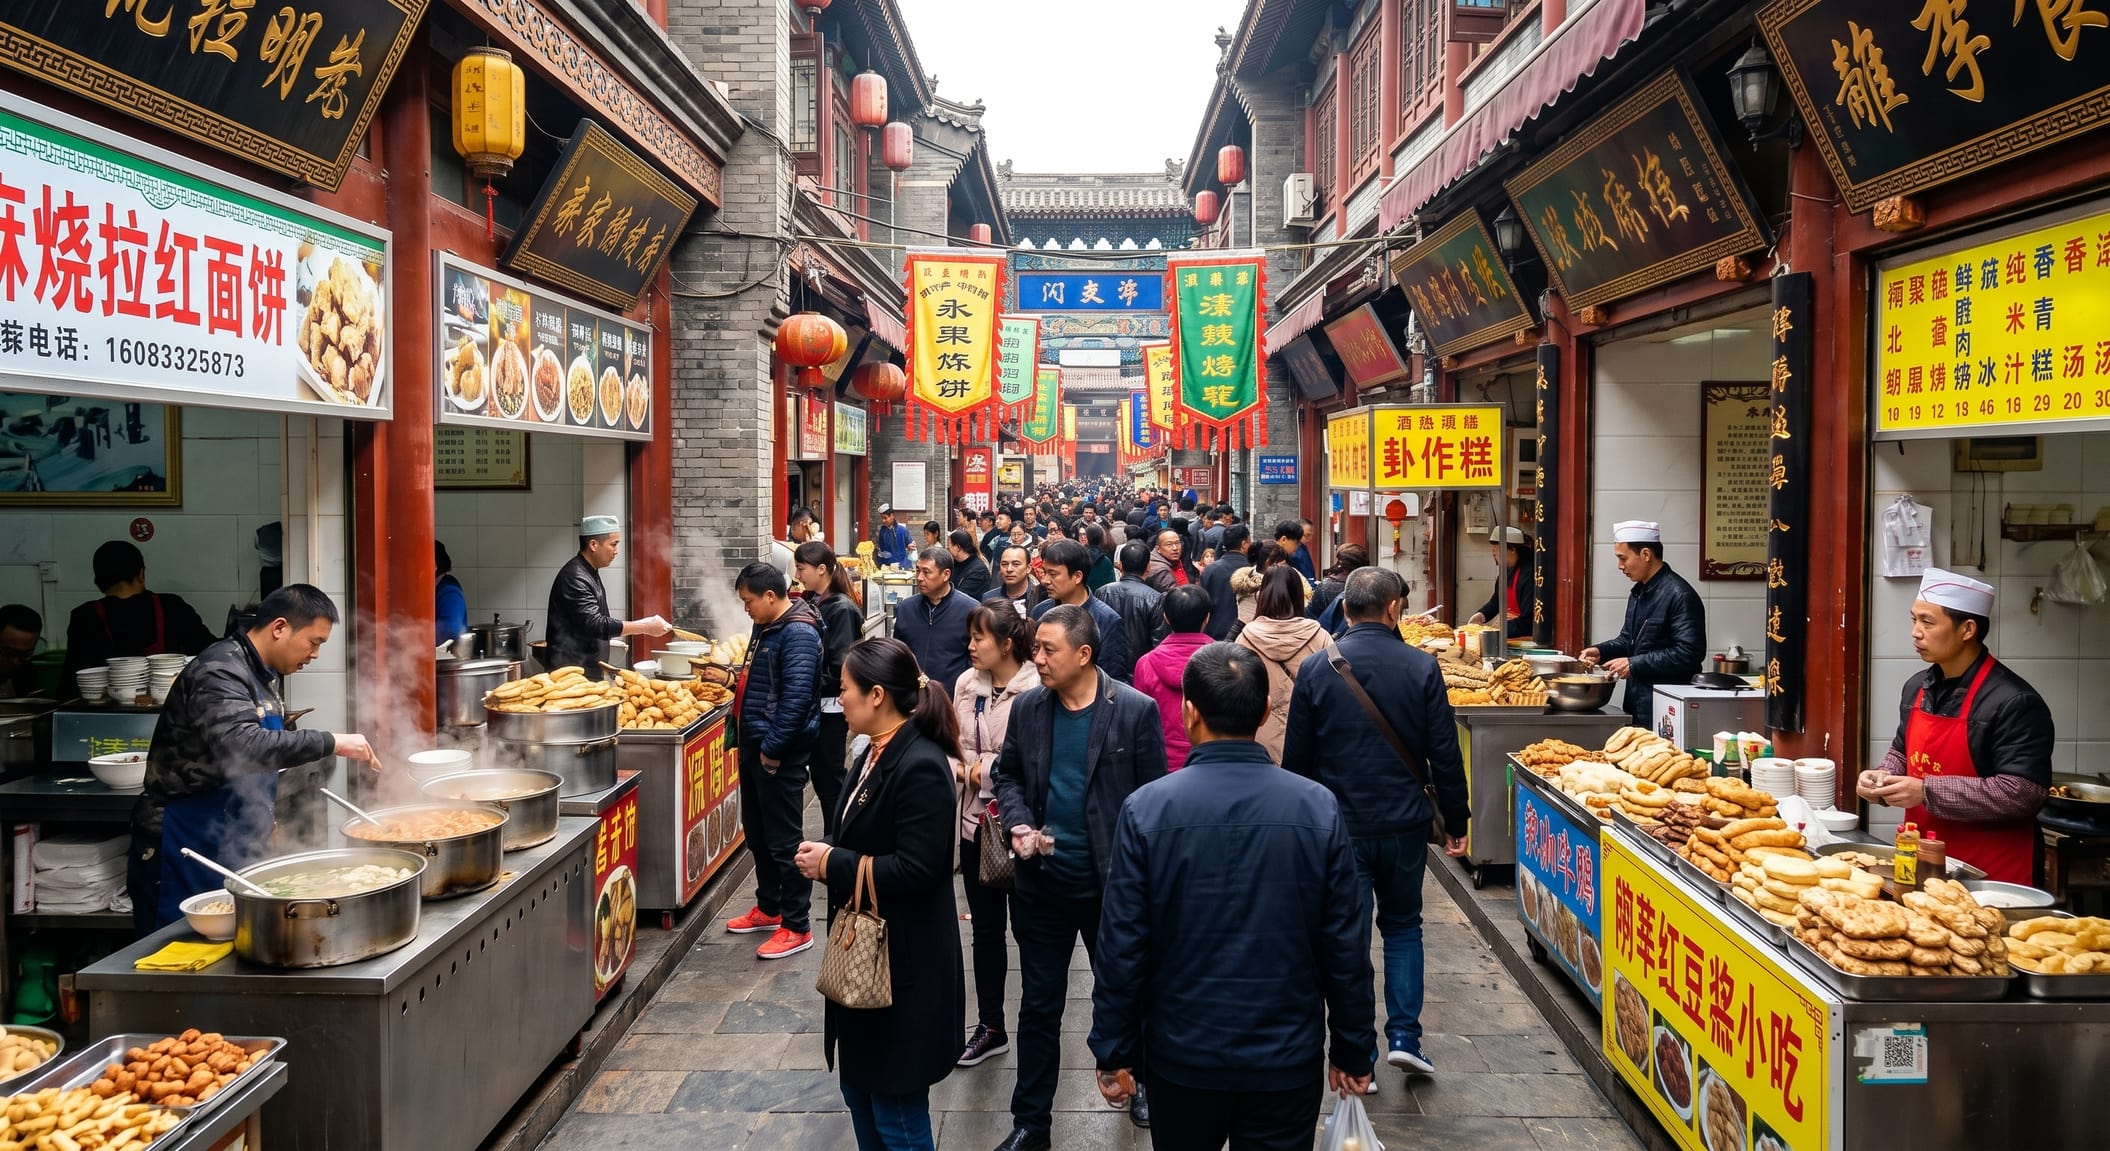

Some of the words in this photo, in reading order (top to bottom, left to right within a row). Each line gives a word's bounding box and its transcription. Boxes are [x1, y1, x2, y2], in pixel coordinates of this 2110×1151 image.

[2032, 244, 2055, 382] 香青糕
[106, 336, 245, 378] 16083325873
[1908, 405, 1921, 421] 19
[1931, 403, 1945, 419] 12
[1979, 398, 1996, 416] 46
[2006, 396, 2022, 414] 18
[2033, 394, 2051, 412] 29
[2063, 391, 2082, 411] 20
[2094, 389, 2110, 408] 30
